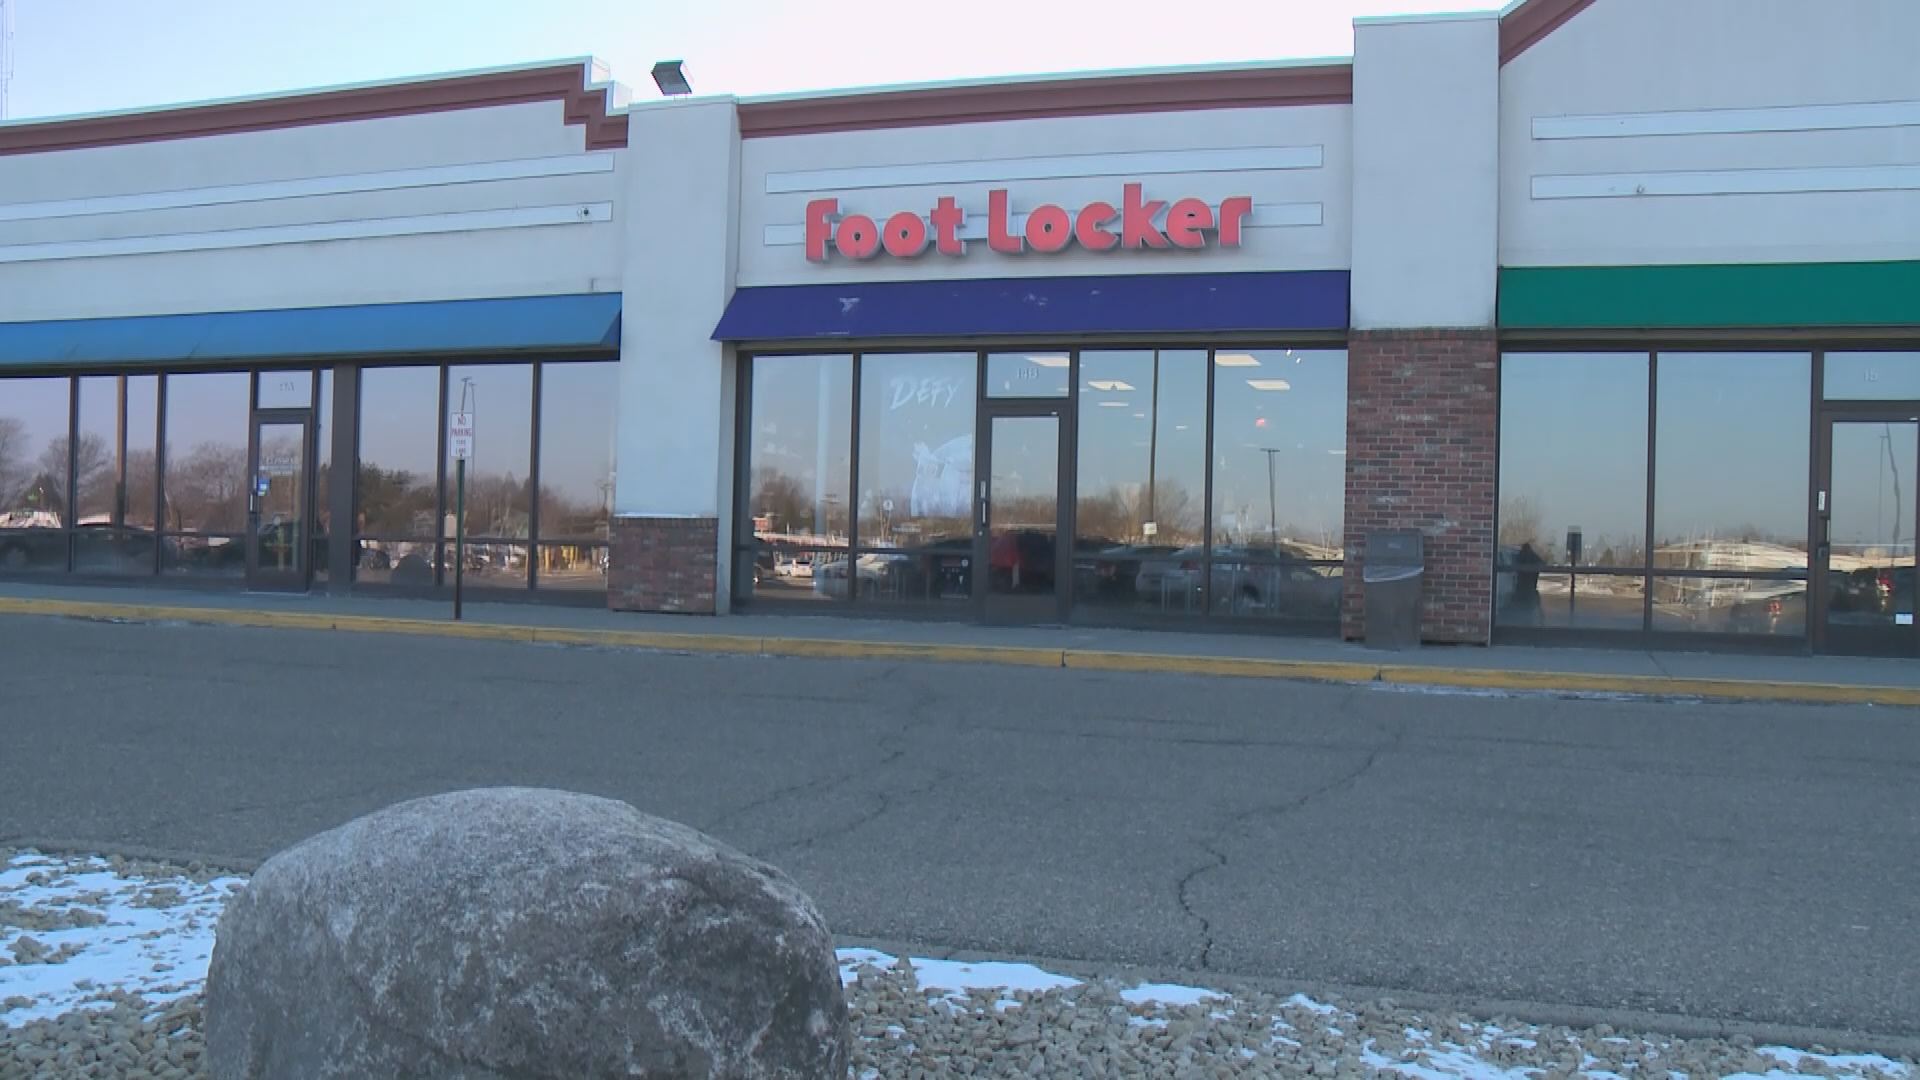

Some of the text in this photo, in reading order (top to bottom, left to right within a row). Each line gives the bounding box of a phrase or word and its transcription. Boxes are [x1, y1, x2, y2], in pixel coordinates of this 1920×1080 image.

[988, 183, 1253, 254] Locker
[889, 375, 964, 410] DEFY
[457, 415, 467, 425] NO
[451, 428, 472, 437] PARKING
